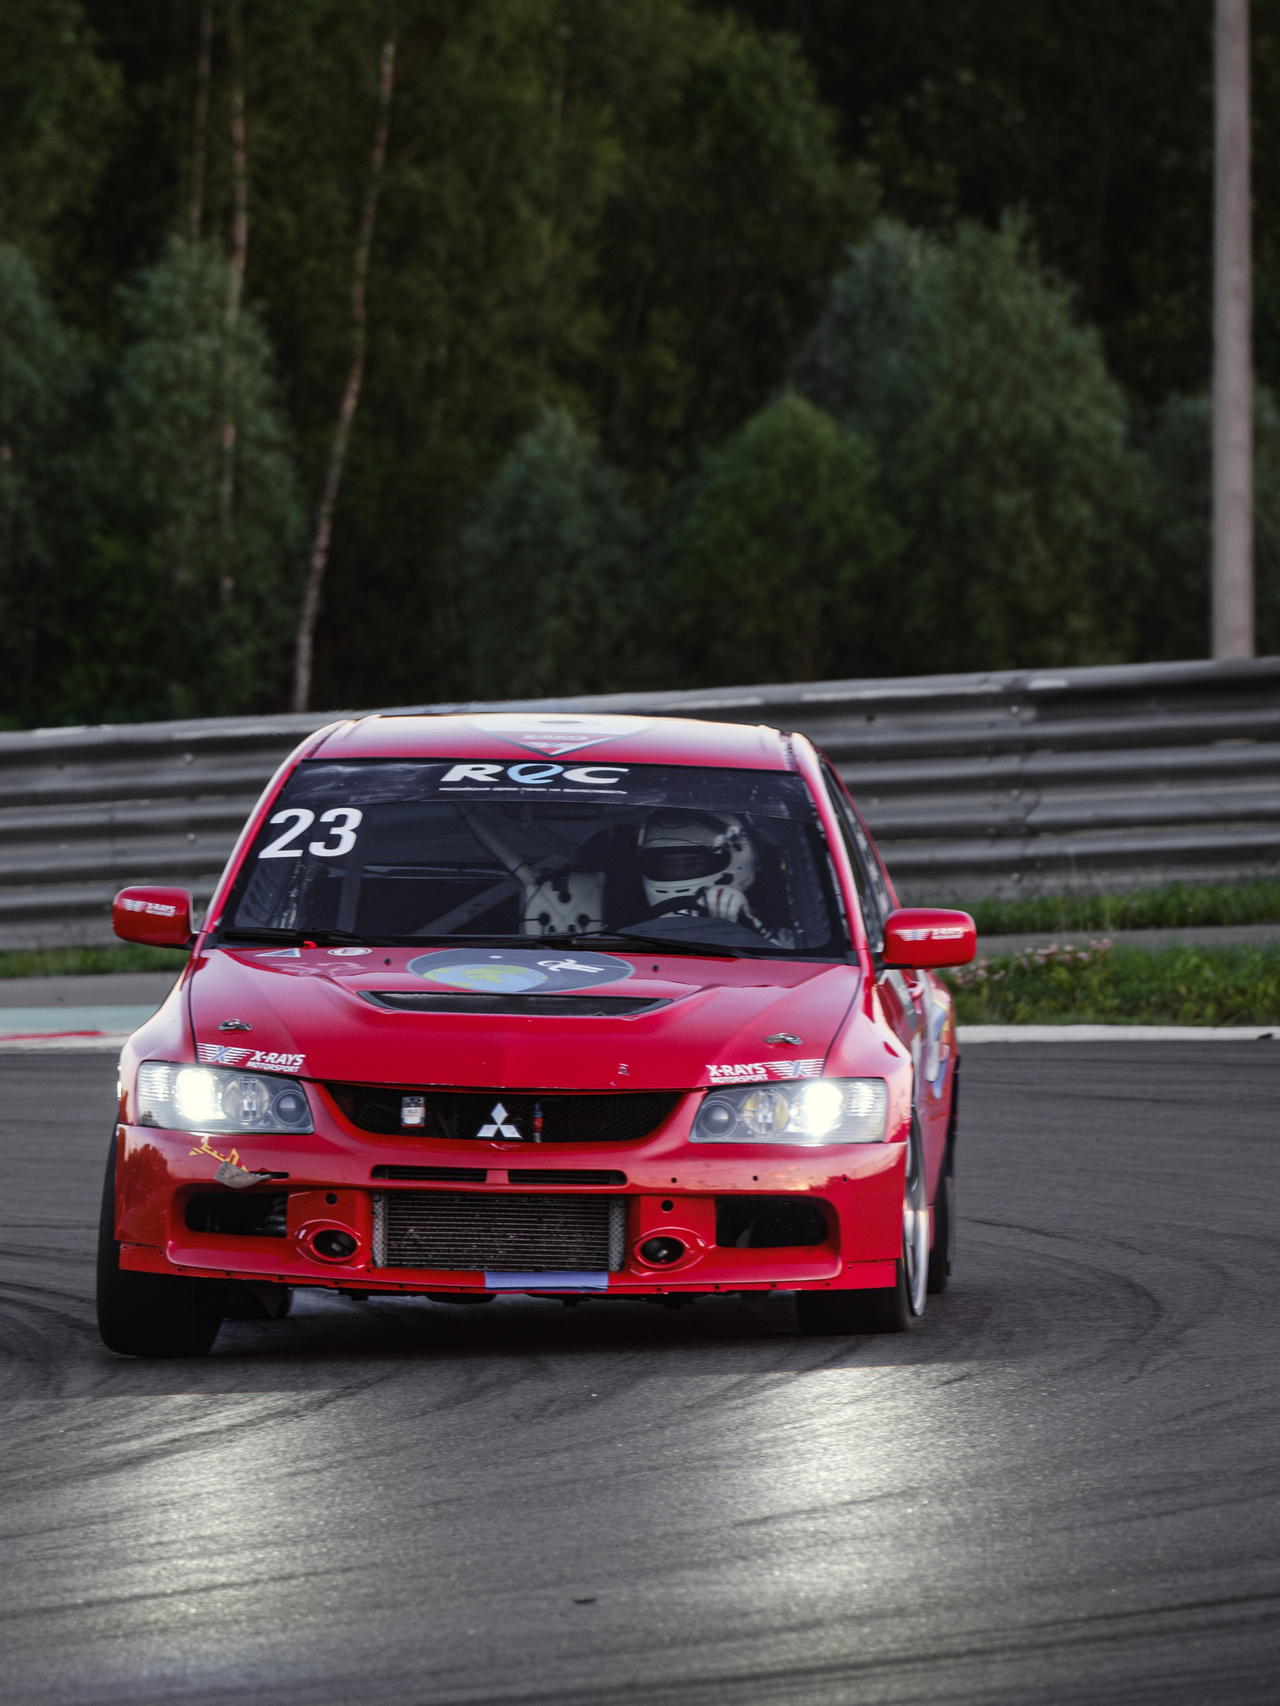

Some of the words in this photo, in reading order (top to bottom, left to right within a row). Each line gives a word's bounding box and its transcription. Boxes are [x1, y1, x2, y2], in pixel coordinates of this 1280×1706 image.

[258, 807, 363, 859] 23
[251, 1051, 306, 1065] X-RAYS
[246, 1061, 300, 1072] MOTORSPORT
[705, 1063, 766, 1077] X-RAYS
[710, 1074, 768, 1084] MOTORSPORT
